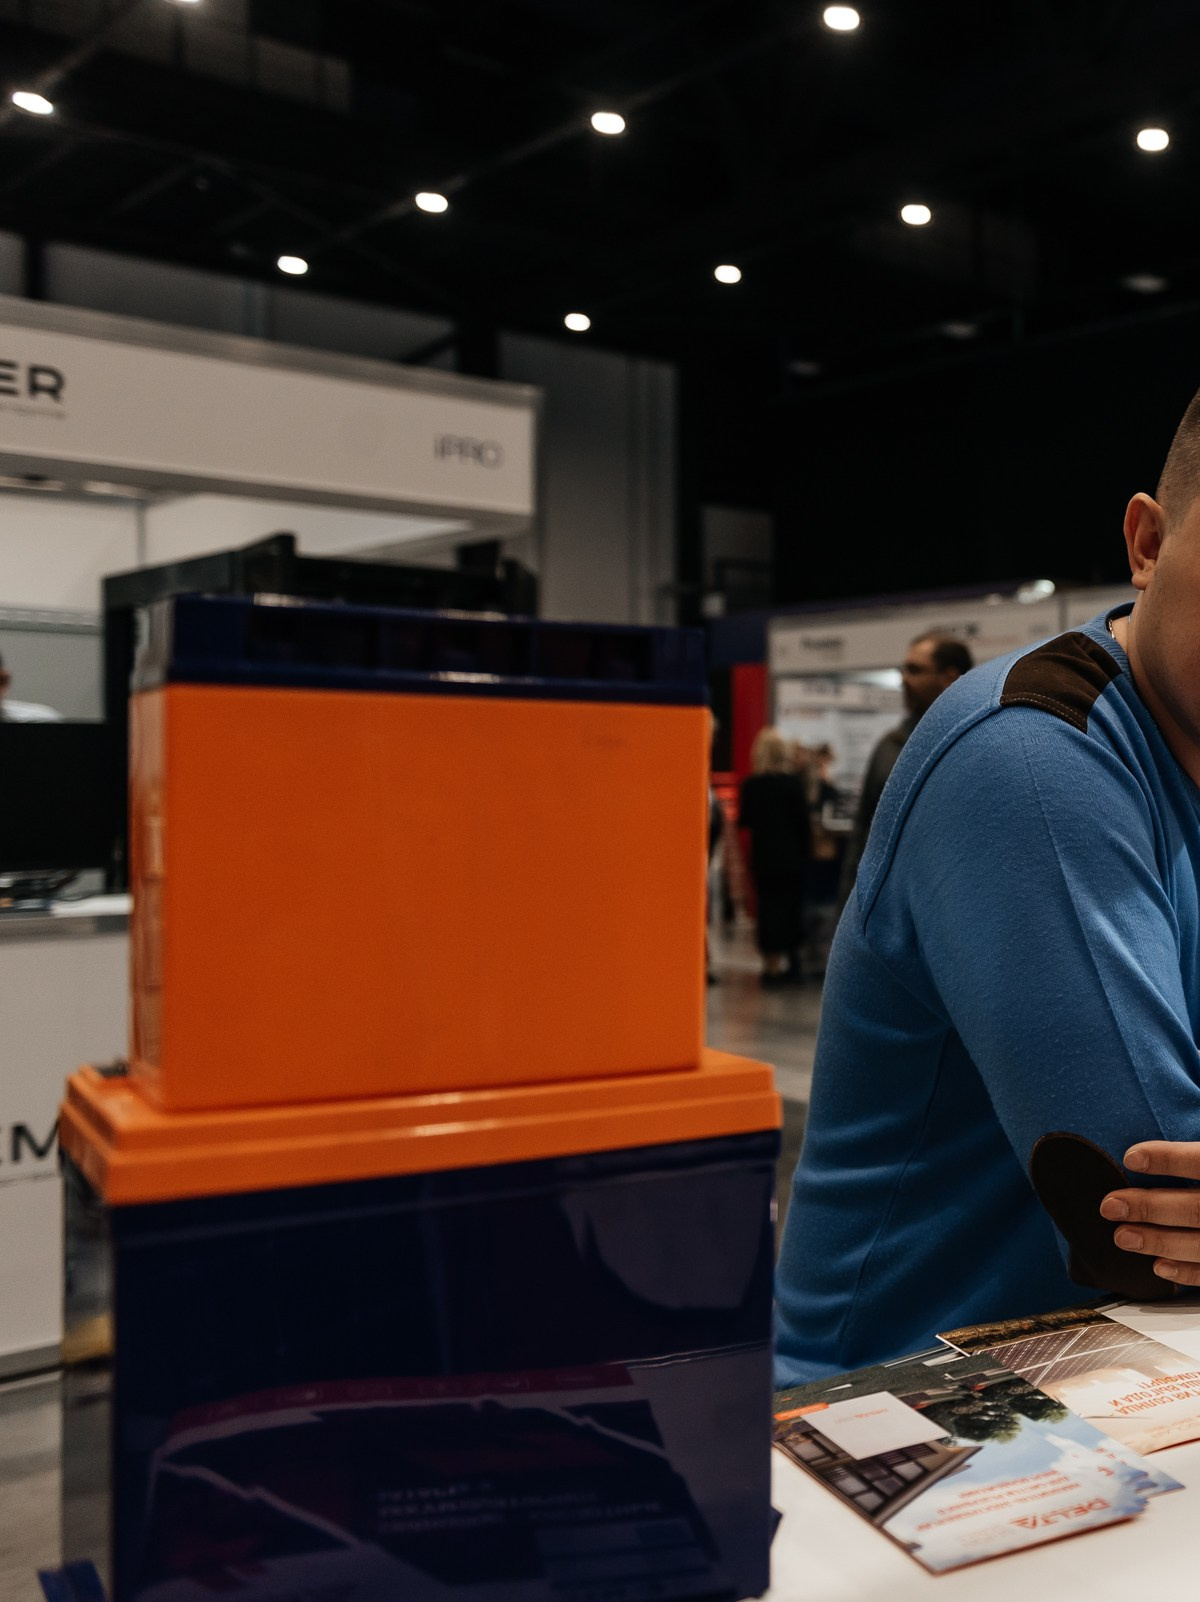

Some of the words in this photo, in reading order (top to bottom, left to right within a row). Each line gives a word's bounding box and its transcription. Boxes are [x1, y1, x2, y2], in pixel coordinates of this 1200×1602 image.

[1120, 1384, 1180, 1403] ВЫГОДА
[1115, 1395, 1174, 1415] СОЛНЦА
[1009, 1497, 1111, 1530] DELTA
